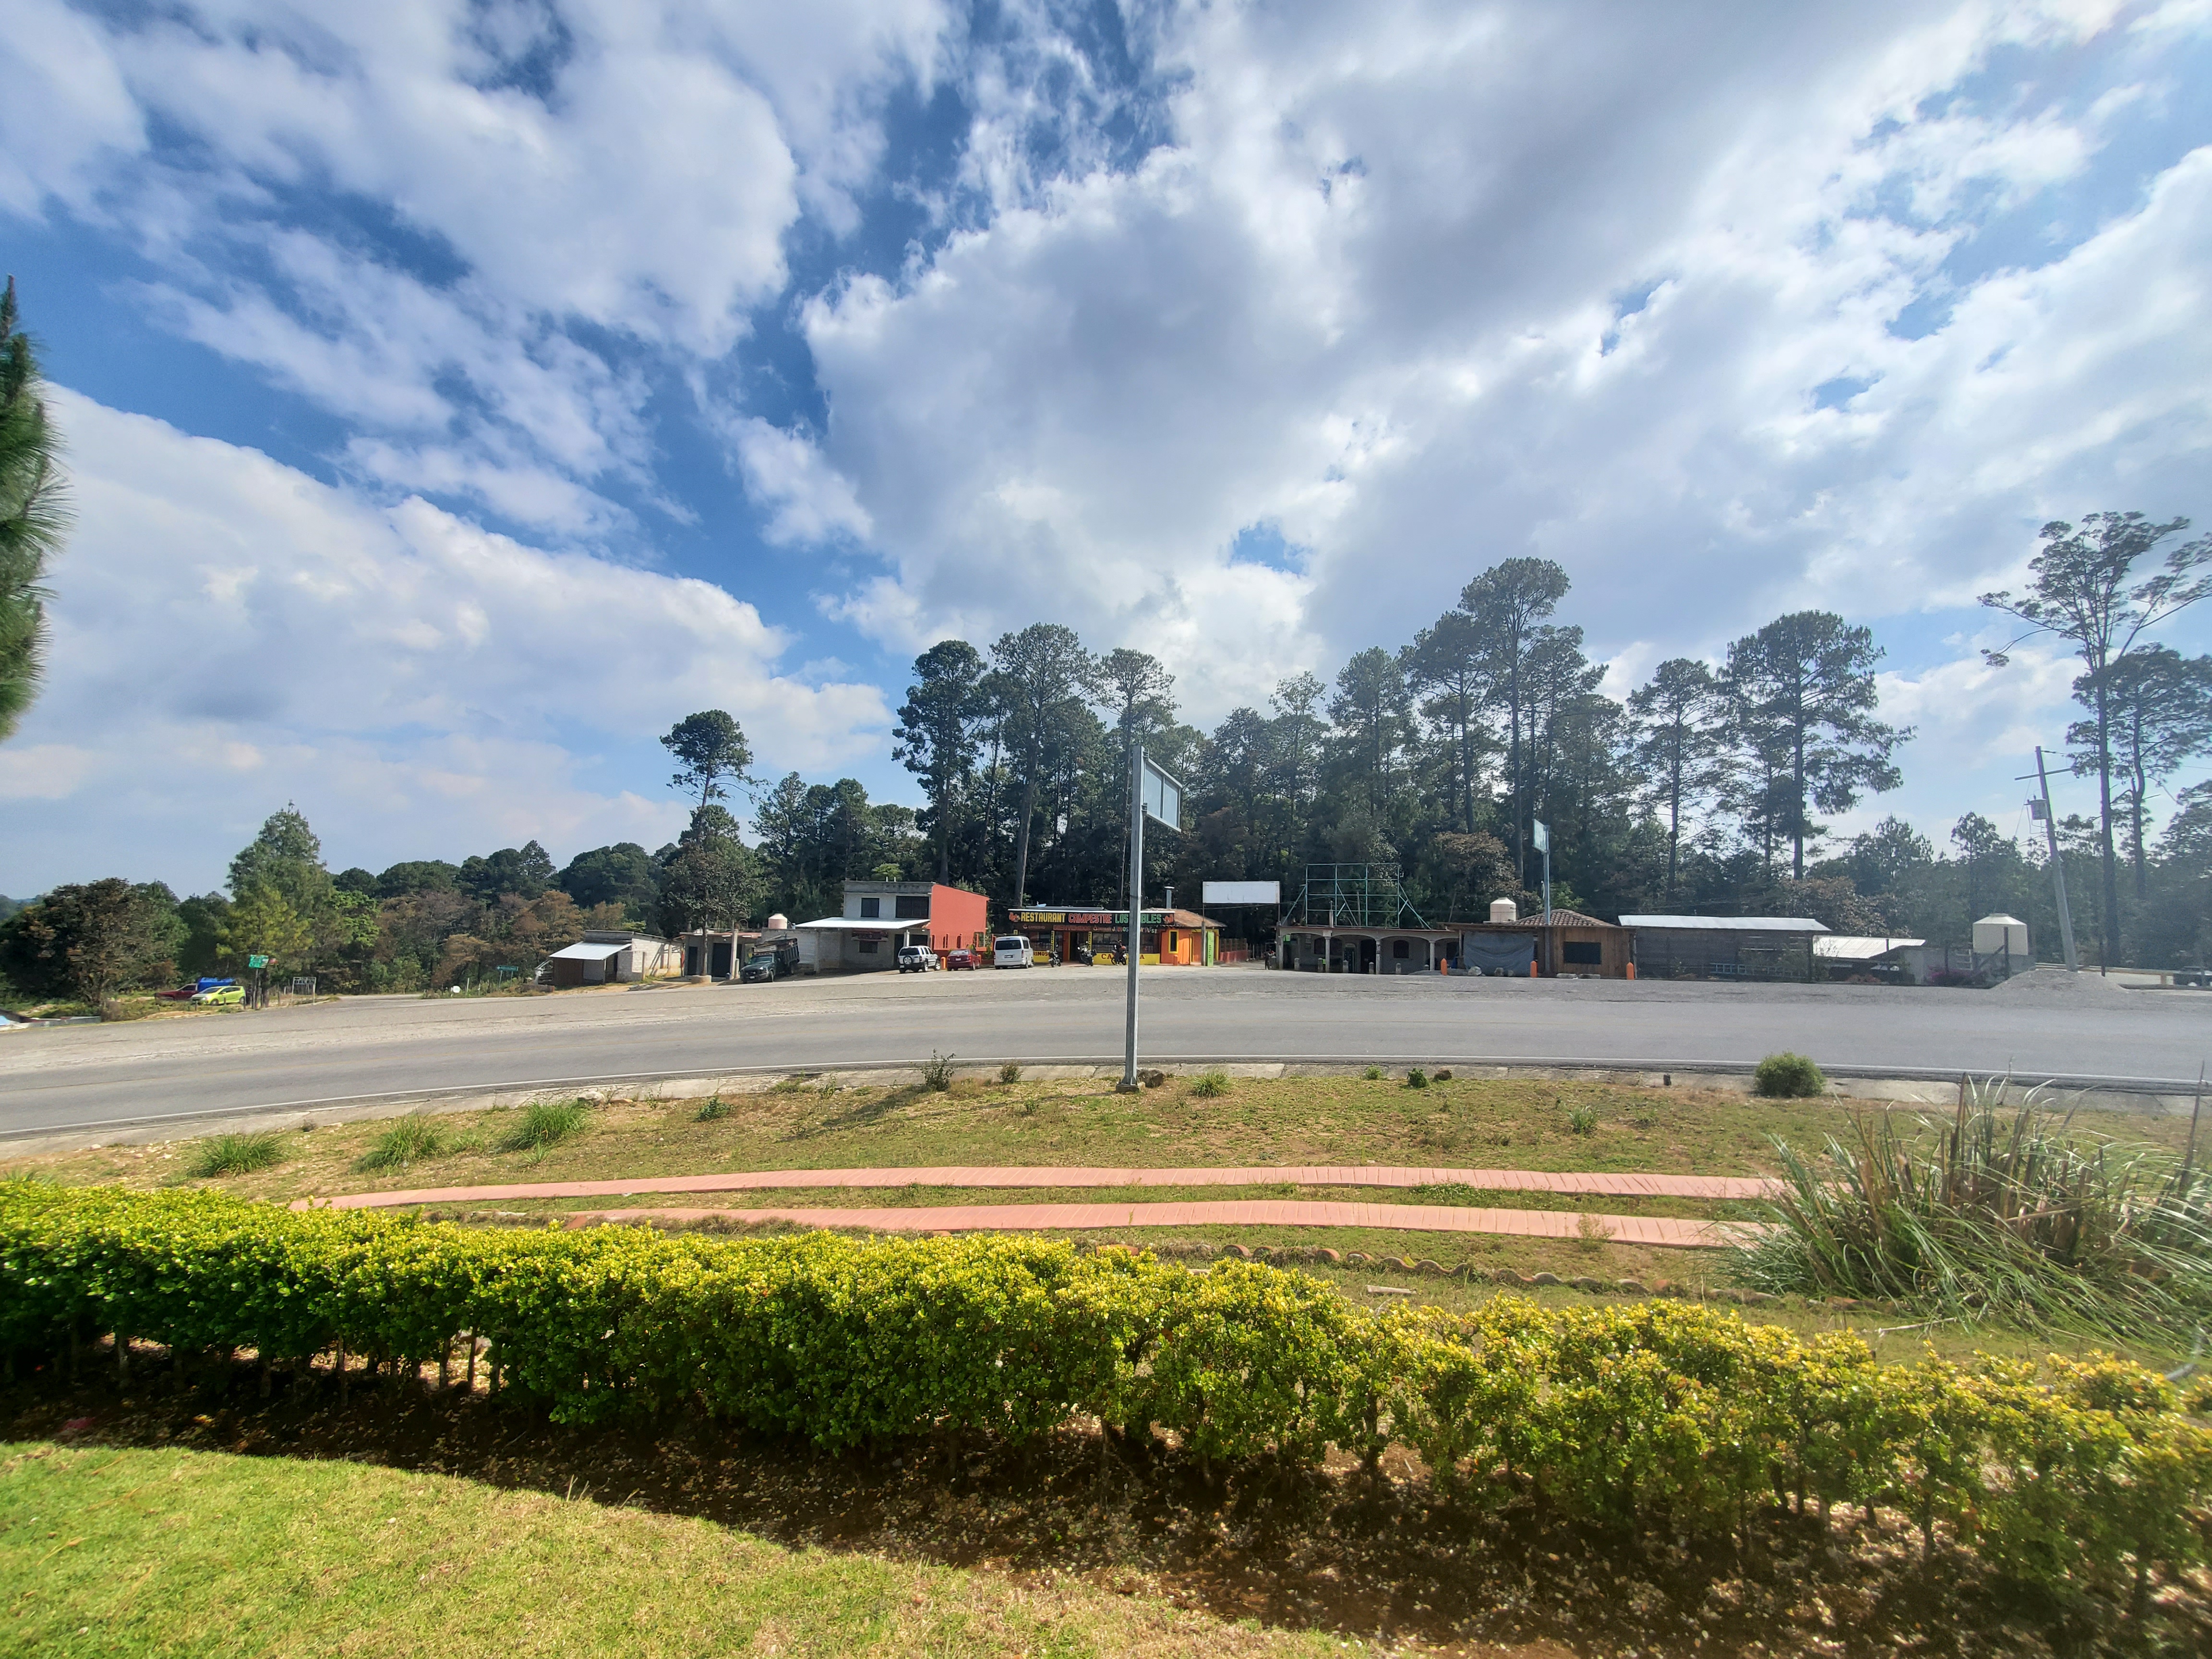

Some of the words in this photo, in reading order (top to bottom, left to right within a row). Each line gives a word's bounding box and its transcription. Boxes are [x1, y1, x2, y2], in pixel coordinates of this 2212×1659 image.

[1021, 912, 1066, 923] RESTAURANT
[1069, 913, 1112, 924] CAMPESTRE
[1115, 914, 1129, 924] LOS
[1141, 914, 1162, 924] BLES
